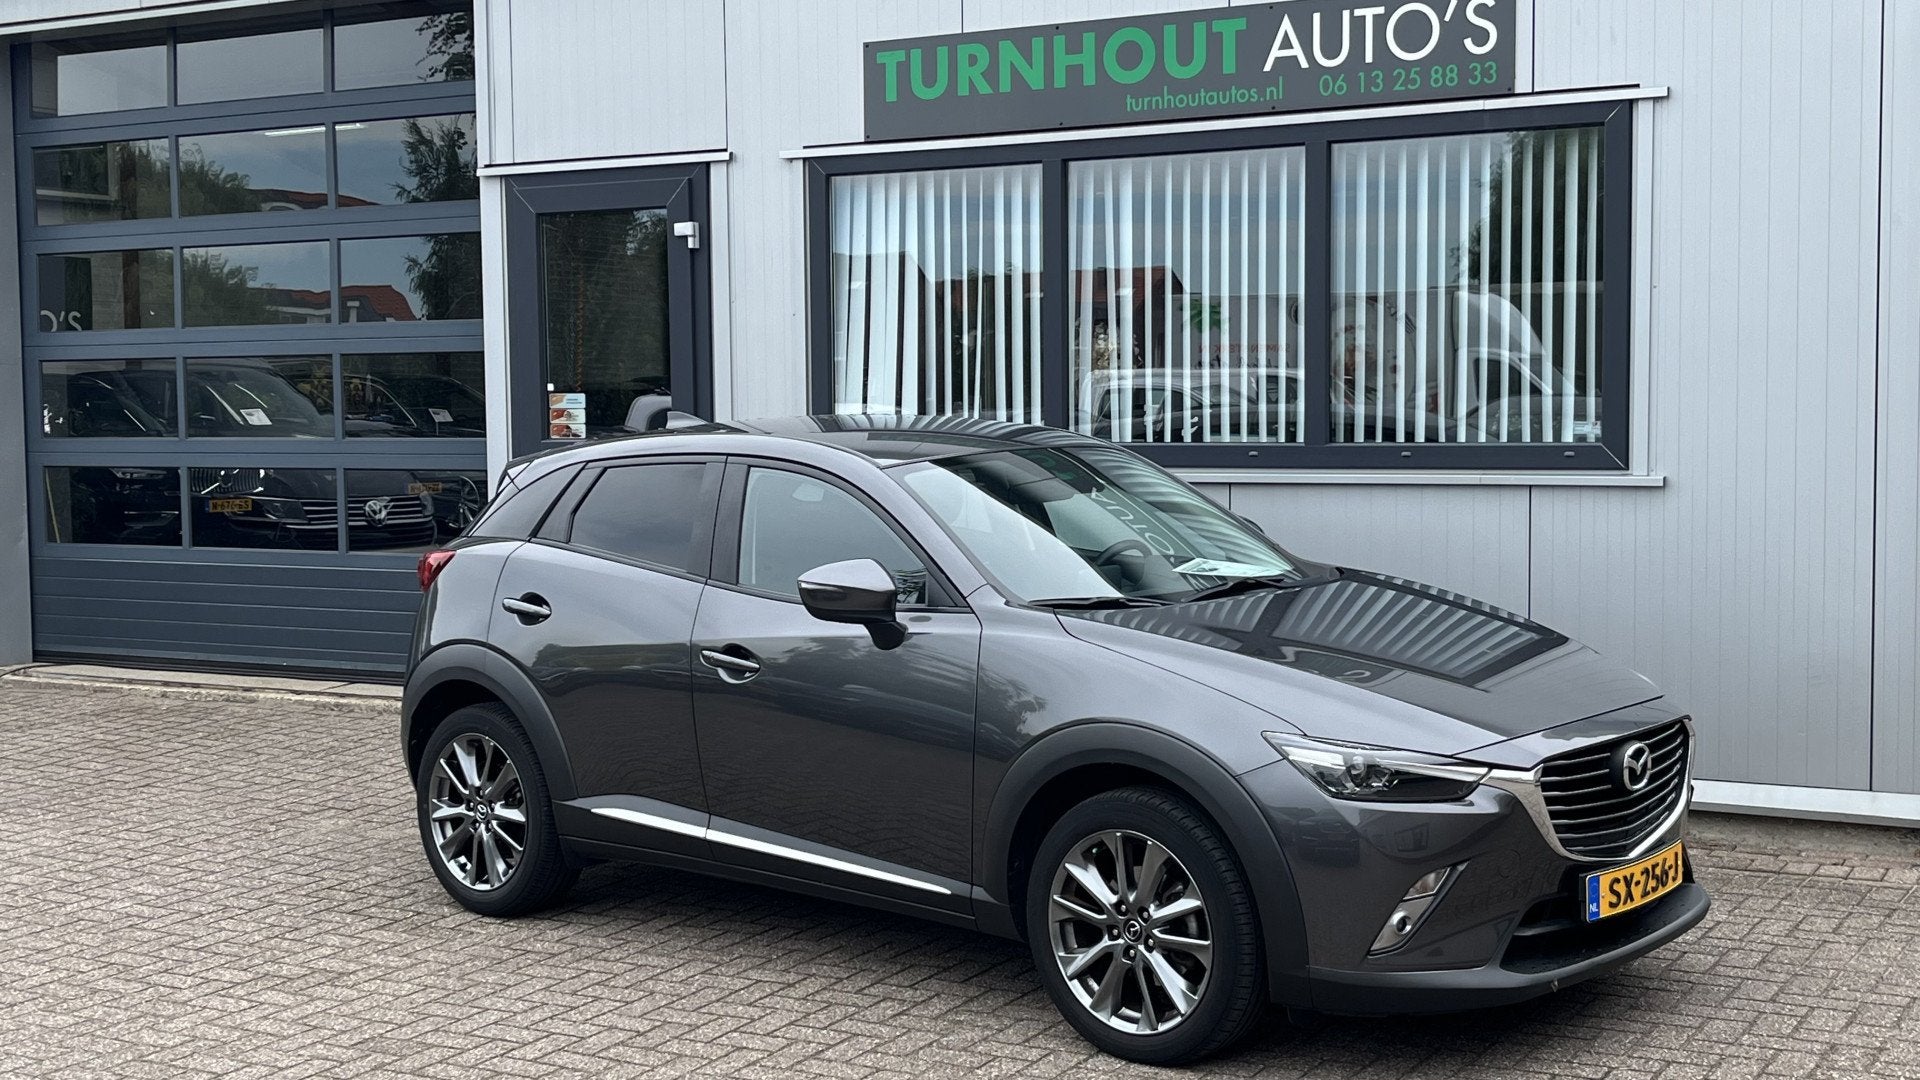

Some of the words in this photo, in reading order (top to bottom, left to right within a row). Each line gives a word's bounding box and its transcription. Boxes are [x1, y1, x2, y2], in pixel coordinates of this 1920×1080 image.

[877, 17, 1247, 103] TURNHOUT
[1262, 0, 1498, 72] AUTO'S
[1126, 76, 1283, 112] turnhoutautos.nl
[1319, 74, 1347, 96] 06
[1358, 70, 1384, 93] 13
[1392, 67, 1421, 91] 25
[1429, 64, 1458, 88] 88
[1467, 61, 1497, 85] 33
[1608, 851, 1679, 909] SX-256-J
[1589, 902, 1599, 914] NL
